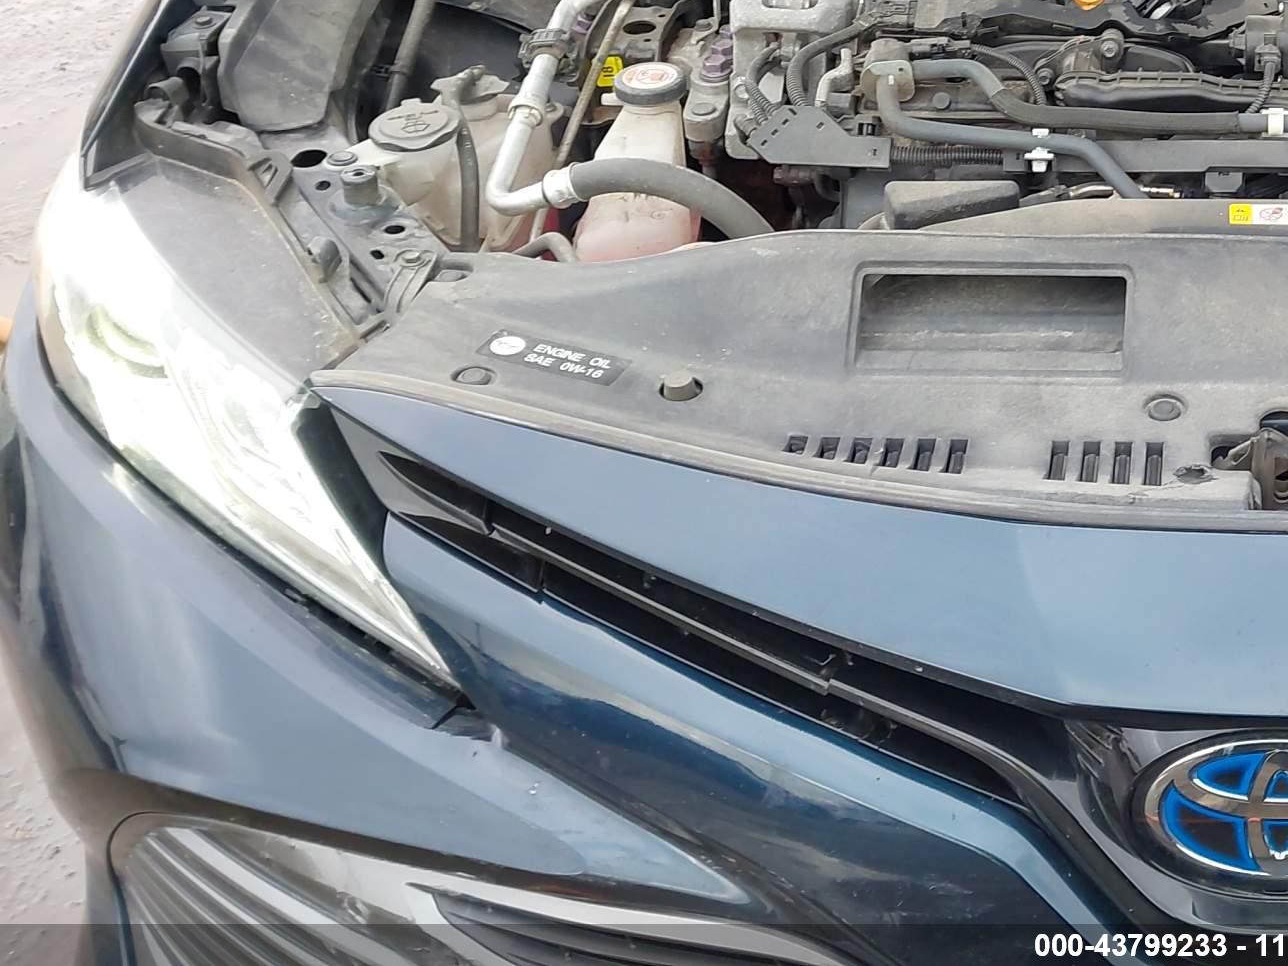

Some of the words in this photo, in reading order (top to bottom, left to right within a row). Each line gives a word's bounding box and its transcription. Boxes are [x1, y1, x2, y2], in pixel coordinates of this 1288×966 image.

[524, 353, 556, 367] SAE
[559, 362, 604, 379] 0W-16
[533, 344, 586, 362] ENGINE
[589, 357, 612, 369] OIL
